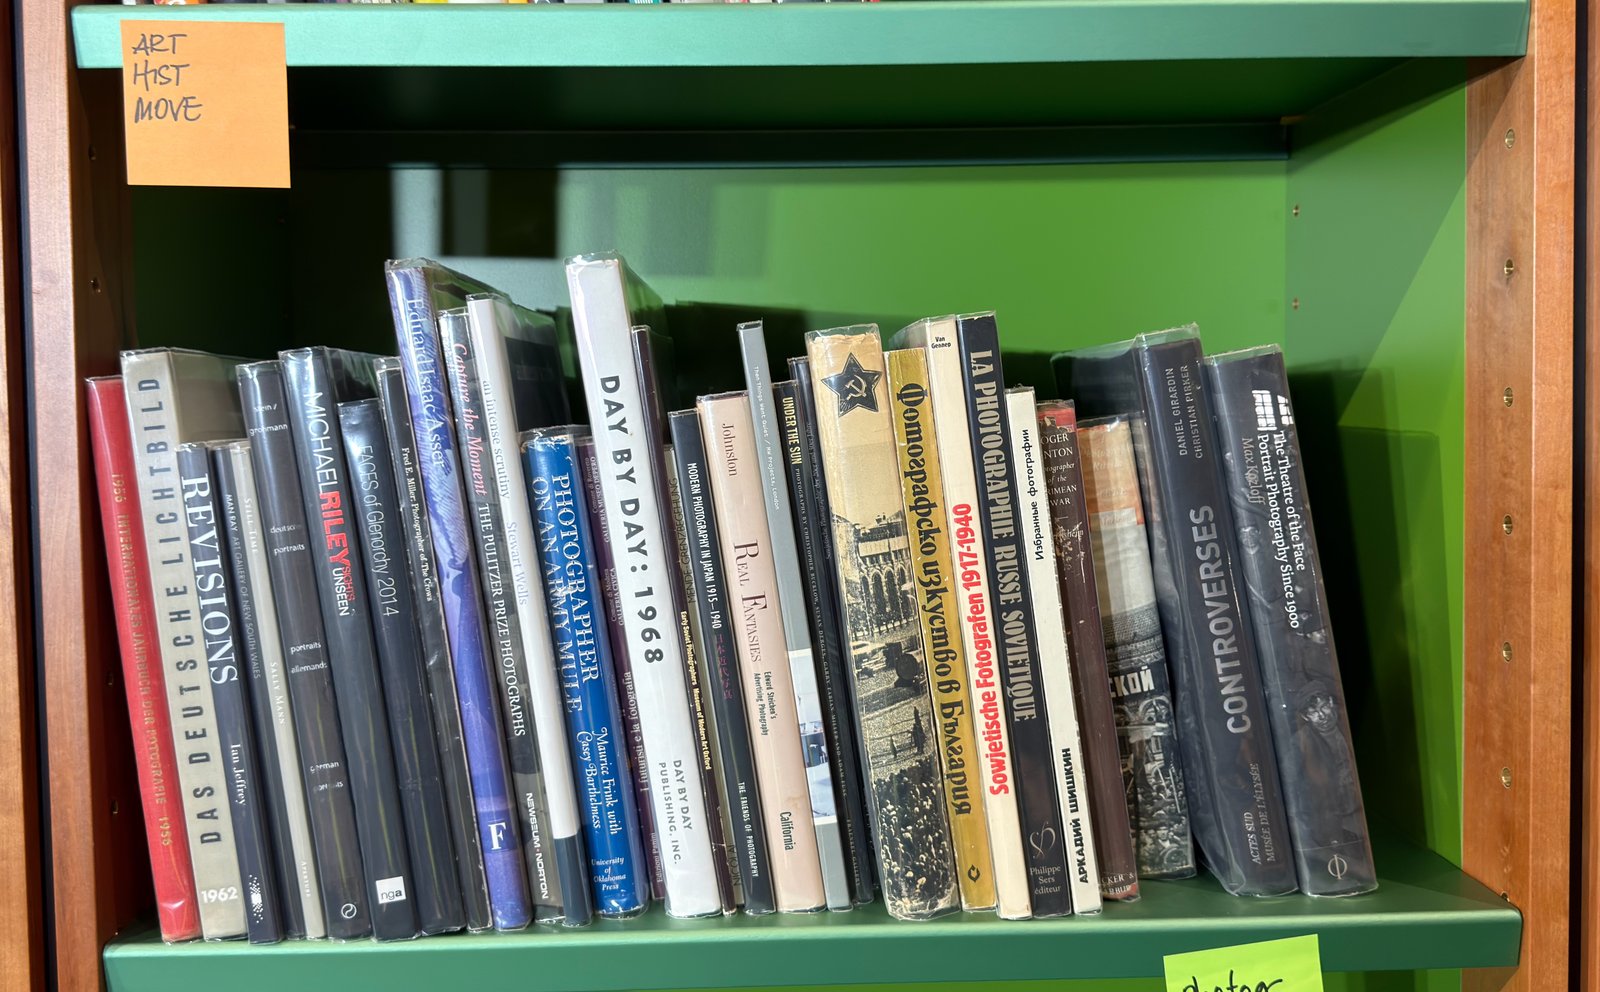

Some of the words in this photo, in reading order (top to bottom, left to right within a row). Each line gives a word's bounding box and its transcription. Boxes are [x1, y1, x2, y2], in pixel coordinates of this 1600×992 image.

[131, 33, 188, 56] ART
[133, 59, 191, 92] HIST
[134, 95, 203, 123] MOVE
[405, 297, 434, 366] Eduard
[452, 341, 472, 403] Capture
[752, 365, 761, 380] Then
[969, 349, 994, 377] LA
[417, 367, 437, 413] Isaac
[481, 379, 493, 396] an
[753, 380, 764, 402] Things
[1164, 366, 1182, 416] GIRARDIN
[1179, 364, 1193, 402] PIRKER
[462, 406, 480, 430] the
[484, 398, 503, 445] intense
[599, 374, 629, 438] DAY
[758, 402, 767, 418] Went
[780, 396, 798, 427] UNDER
[302, 391, 339, 494] MICHAEL
[425, 415, 446, 469] Asser
[760, 418, 770, 437] Quiet
[785, 426, 800, 445] THE
[1173, 418, 1188, 456] DANIEL
[1186, 405, 1203, 459] CHRISTIAN
[1271, 429, 1288, 456] The
[401, 446, 412, 465] Fred
[465, 433, 491, 497] Moment
[720, 421, 739, 477] Johnston
[788, 445, 803, 466] SUN
[973, 380, 1014, 539] PHOTOGRAPHIE
[1021, 428, 1038, 497] фотографии
[1239, 435, 1257, 464] Max
[1256, 433, 1277, 482] Portrait
[137, 377, 183, 565] LICHTBILD
[355, 444, 378, 491] FACES
[404, 466, 414, 476] E.
[493, 447, 510, 500] scrutiny
[610, 447, 637, 487] BY
[685, 462, 701, 495] MODERN
[896, 381, 938, 557] Фотографско
[1275, 455, 1297, 505] Theatre
[111, 472, 126, 503] 1956
[363, 493, 381, 507] of
[529, 474, 552, 513] ON
[770, 487, 781, 510] London
[1244, 463, 1265, 508] Kozloff
[225, 493, 235, 514] MAN
[476, 503, 492, 531] THE
[1284, 504, 1300, 521] of
[228, 515, 238, 531] RAY
[318, 490, 350, 568] RILEY
[410, 502, 425, 552] Photographer
[536, 517, 559, 555] AN
[619, 496, 650, 573] DAY:
[690, 495, 710, 549] PHOTOGRAPHY
[1030, 500, 1044, 560] Избранные
[1264, 482, 1289, 564] Photography
[1287, 519, 1304, 542] the
[232, 536, 241, 551] ART
[274, 544, 305, 557] portraits
[365, 508, 389, 575] Glenorchy
[418, 552, 428, 561] of
[504, 521, 523, 568] Stewart
[699, 549, 711, 559] IN
[951, 502, 982, 592] 1917-1940
[1291, 541, 1308, 571] Face
[180, 472, 238, 685] REVISIONS
[234, 551, 246, 584] GALLERY
[420, 561, 431, 577] The
[482, 534, 503, 596] PULITZER
[550, 472, 600, 683] PHOTOGRAPHER
[608, 566, 619, 591] CIVICA
[699, 558, 715, 583] JAPAN
[993, 543, 1022, 605] RUSSE
[1279, 562, 1298, 599] Since
[239, 586, 248, 597] OF
[331, 566, 350, 616] UNSEEN
[376, 575, 399, 617] 2014
[422, 576, 435, 602] Crows
[513, 570, 529, 605] Wells
[542, 558, 572, 634] ARMY
[242, 599, 252, 620] NEW
[492, 598, 510, 637] PRIZE
[613, 591, 625, 626] GALLERIA
[632, 585, 665, 664] 1968
[678, 610, 689, 626] Early
[918, 558, 956, 677] изкуство
[1187, 503, 1253, 735] CONTROVERSES
[1281, 599, 1300, 630] 1900
[245, 623, 257, 650] SOUTH
[290, 641, 322, 655] portraits
[681, 624, 692, 644] Soviet
[966, 592, 995, 689] Fotografen
[131, 630, 153, 695] JAHRBUCH
[165, 583, 211, 764] DEUTSCHE
[249, 652, 261, 679] WALES
[555, 639, 584, 713] MULE
[684, 643, 699, 686] Photographers
[997, 608, 1036, 721] SOVIETIQUE
[498, 638, 526, 736] PHOTOGRAPHS
[621, 670, 639, 721] fotografia
[752, 671, 764, 703] Advertising
[763, 670, 774, 690] Edward
[935, 677, 961, 695] в
[141, 699, 155, 724] DER
[692, 687, 703, 712] Museum
[629, 722, 641, 733] la
[697, 718, 708, 740] Modern
[757, 703, 768, 736] Photography
[229, 742, 243, 763] Ian
[592, 726, 611, 776] Maurice
[633, 734, 642, 742] e
[700, 739, 710, 751] Art
[979, 689, 1010, 796] Sowjetische
[633, 743, 649, 784] futuristi
[672, 759, 685, 784] DAY
[701, 750, 713, 770] Oxford
[938, 698, 972, 816] България
[233, 765, 246, 807] Jeffrey
[576, 729, 591, 762] Casey
[584, 762, 602, 829] Barthelmess
[600, 776, 620, 808] Frink
[676, 786, 688, 803] BY
[737, 781, 746, 794] THE
[1060, 747, 1080, 813] ШИШКИН
[191, 784, 222, 844] DAS
[605, 809, 623, 836] with
[656, 761, 678, 837] PUBLISHING,
[669, 839, 682, 864] INC.
[679, 805, 693, 831] DAY
[739, 795, 750, 822] FRIENDS
[1242, 810, 1255, 832] SUD
[1258, 810, 1269, 826] DE
[158, 816, 173, 847] 1956
[487, 822, 507, 850] F
[743, 823, 752, 833] OF
[778, 810, 796, 851] California
[591, 857, 624, 866] University
[745, 834, 759, 878] PHOTOGRAPHY
[1069, 817, 1089, 884] АРКАДИЙ
[1246, 831, 1262, 865] ACTES
[593, 873, 626, 883] Oklahoma
[602, 883, 619, 891] Press
[604, 866, 611, 875] of
[1030, 866, 1061, 876] Philippe
[1038, 875, 1056, 884] Sers
[201, 886, 238, 903] 1962
[380, 888, 403, 901] nga
